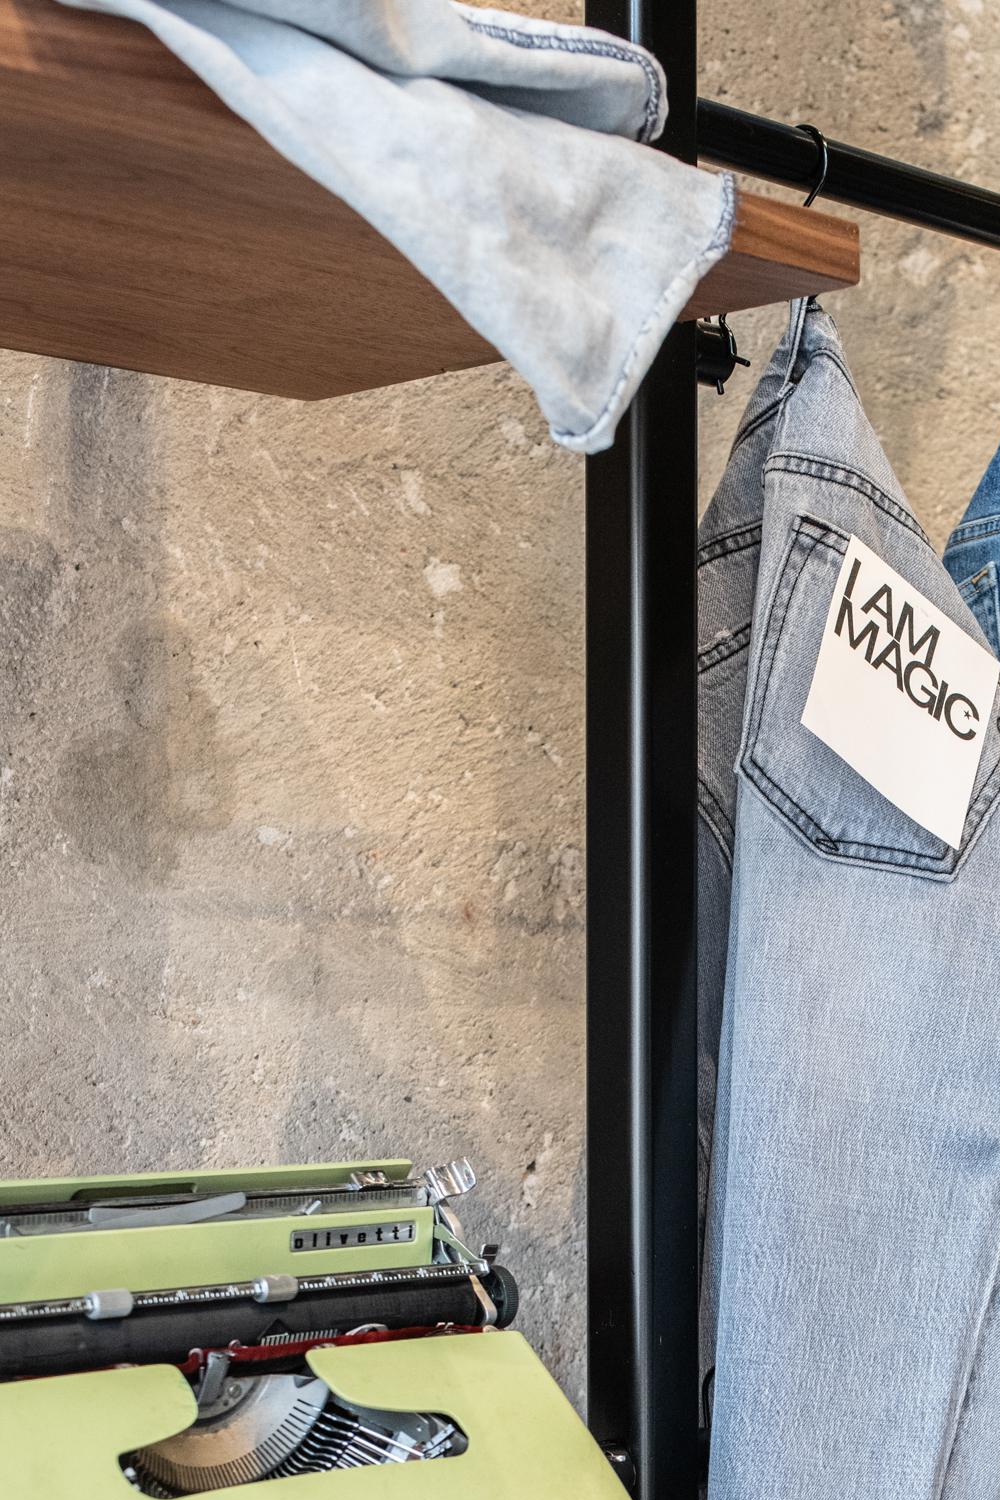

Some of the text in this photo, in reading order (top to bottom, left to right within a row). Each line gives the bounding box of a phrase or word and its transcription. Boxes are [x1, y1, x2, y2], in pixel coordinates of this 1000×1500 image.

[834, 595, 980, 741] MAGIC
[843, 557, 941, 669] I AM
[294, 1225, 412, 1249] olivetti
